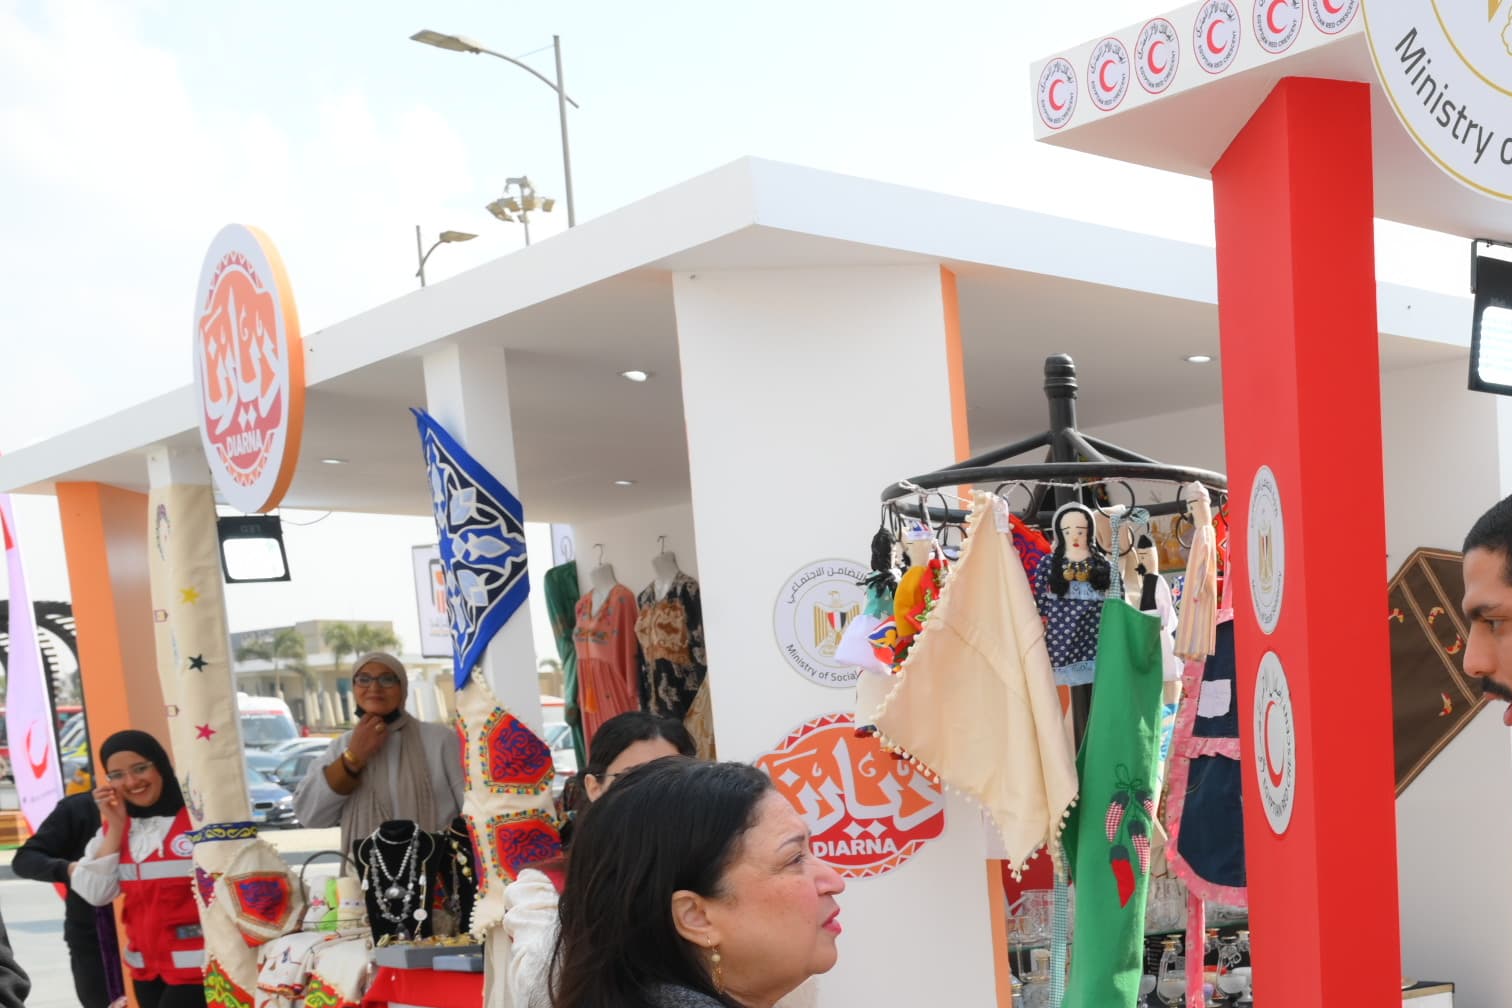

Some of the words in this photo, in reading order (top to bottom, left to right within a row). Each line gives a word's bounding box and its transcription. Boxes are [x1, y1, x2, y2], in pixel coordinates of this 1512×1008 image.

[1394, 27, 1494, 164] Ministry
[226, 428, 264, 459] DIARNA
[785, 643, 817, 677] Ministry
[818, 671, 830, 680] of
[830, 669, 858, 682] Social
[812, 837, 898, 859] DIARNA
